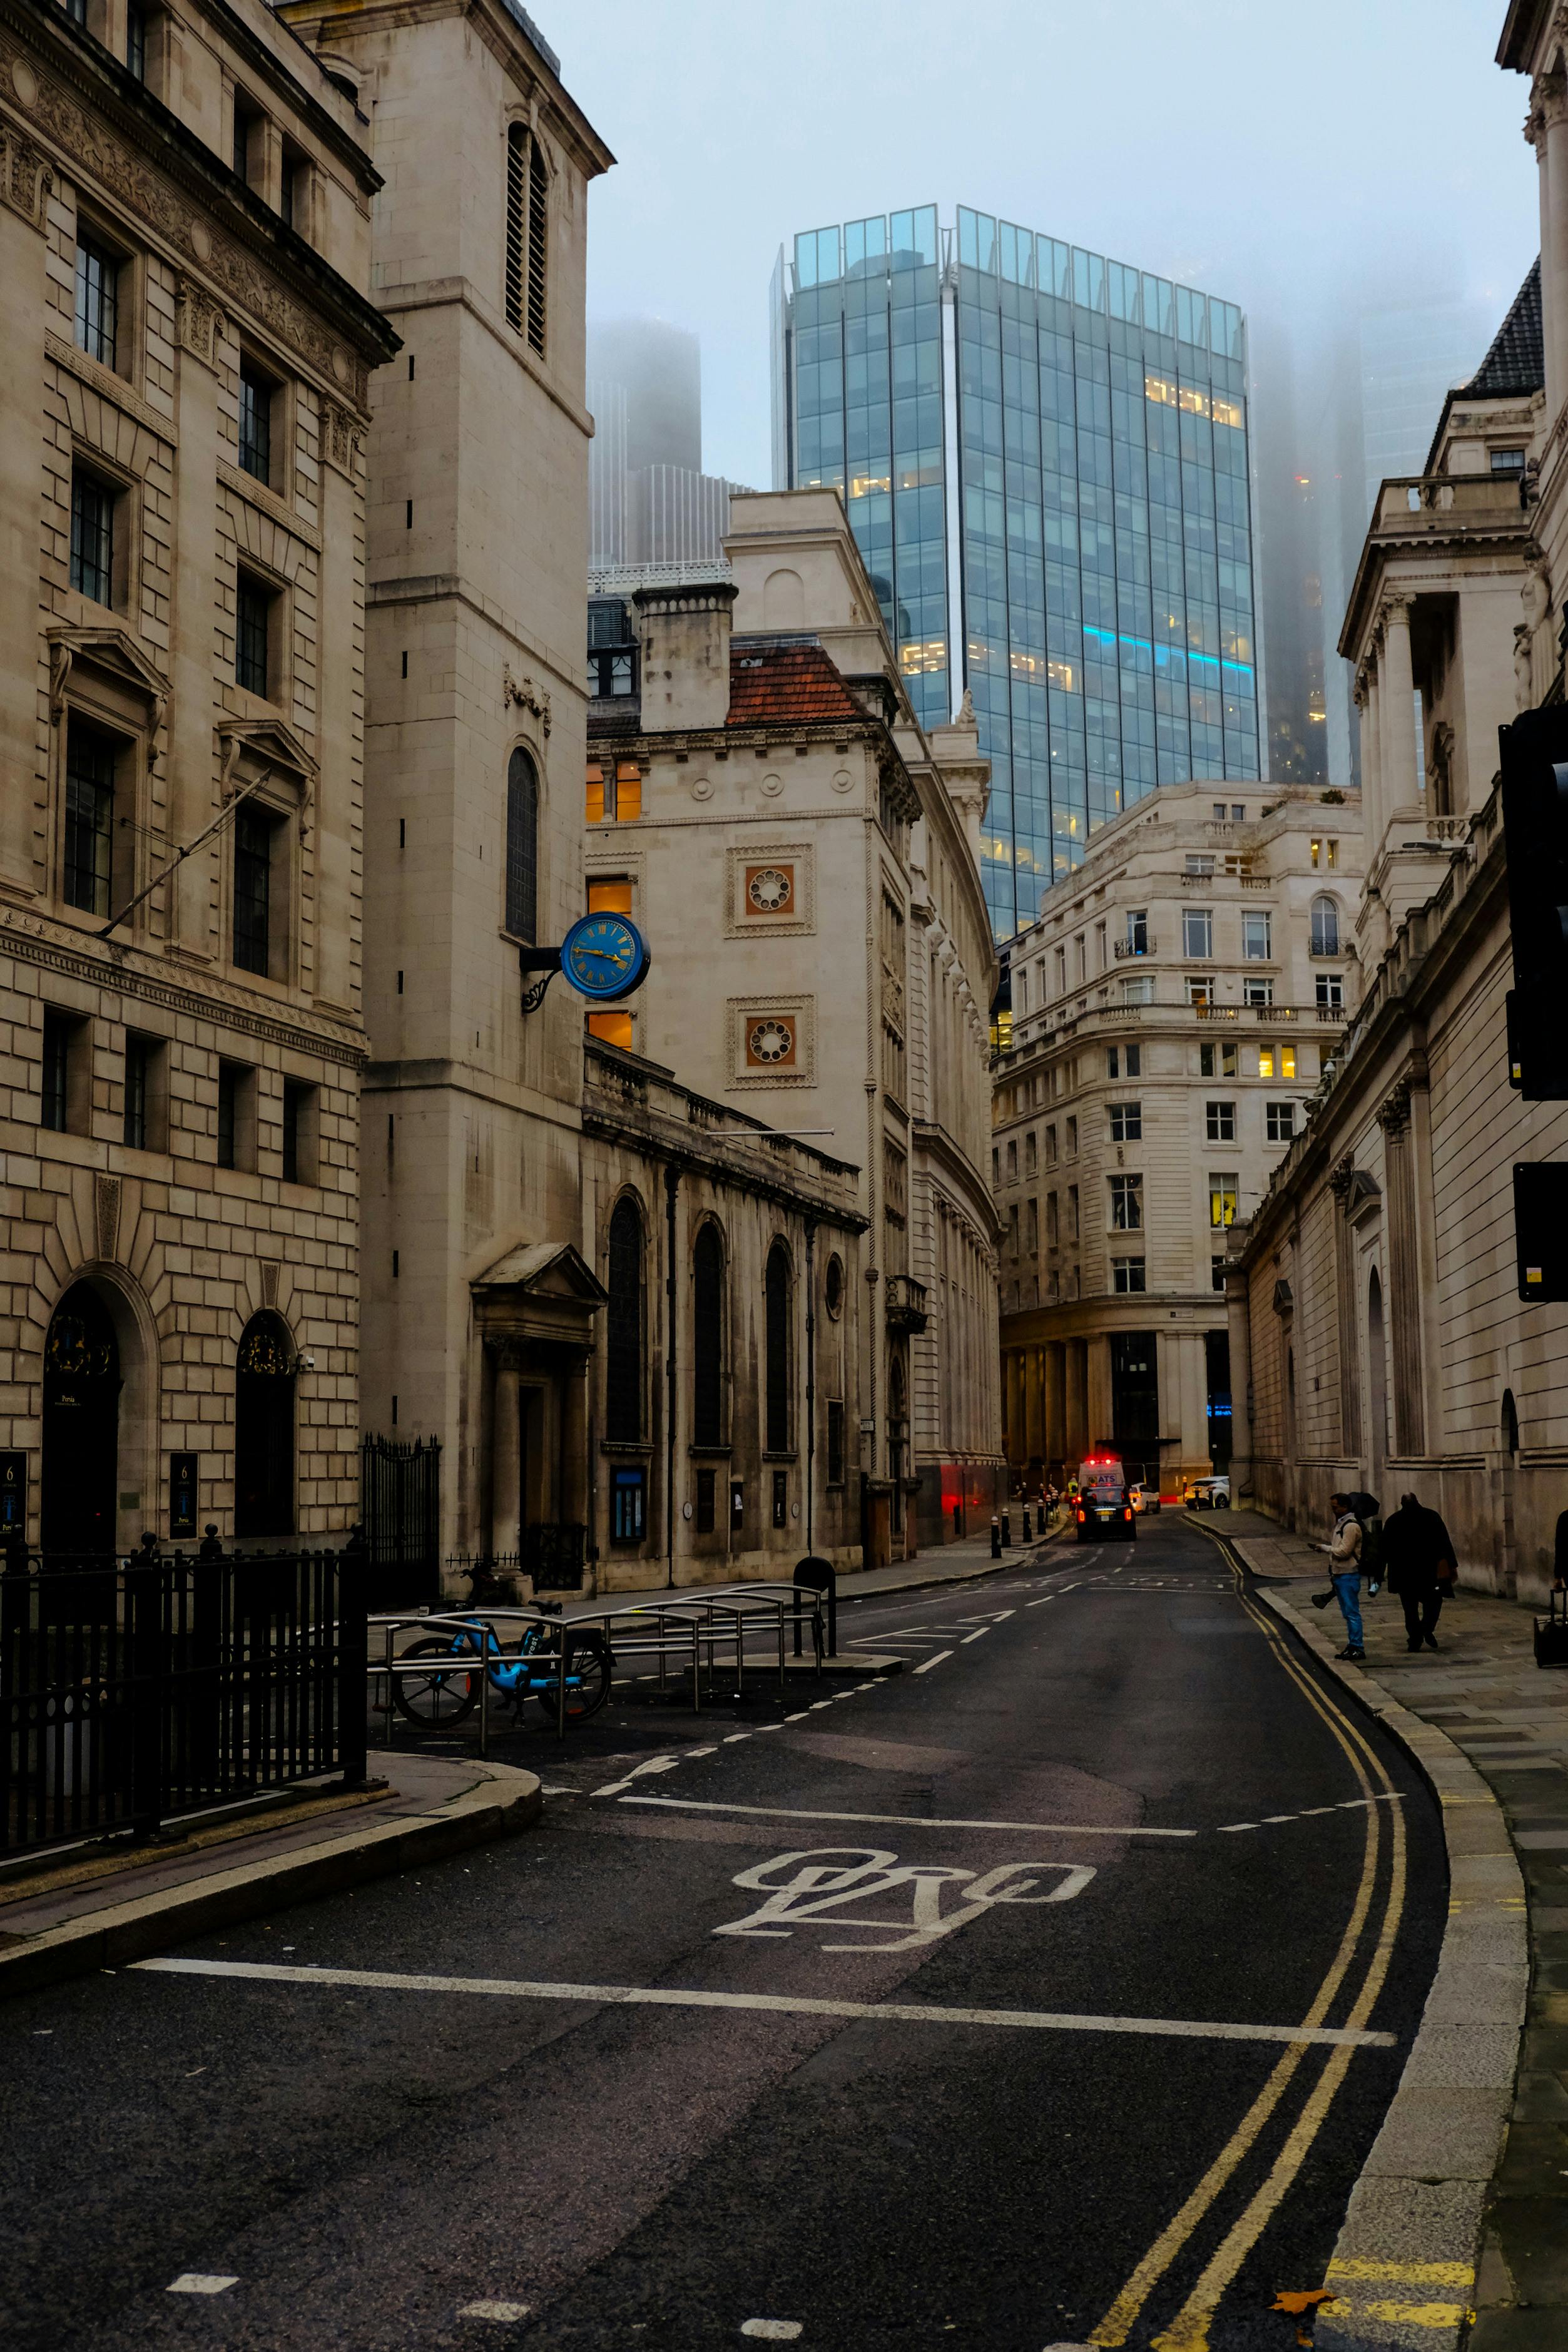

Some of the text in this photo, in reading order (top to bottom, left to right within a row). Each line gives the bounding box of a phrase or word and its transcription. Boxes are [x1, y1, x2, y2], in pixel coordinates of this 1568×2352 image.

[7, 1466, 14, 1481] 6
[181, 1465, 188, 1479] 6
[528, 1636, 539, 1655] rest
